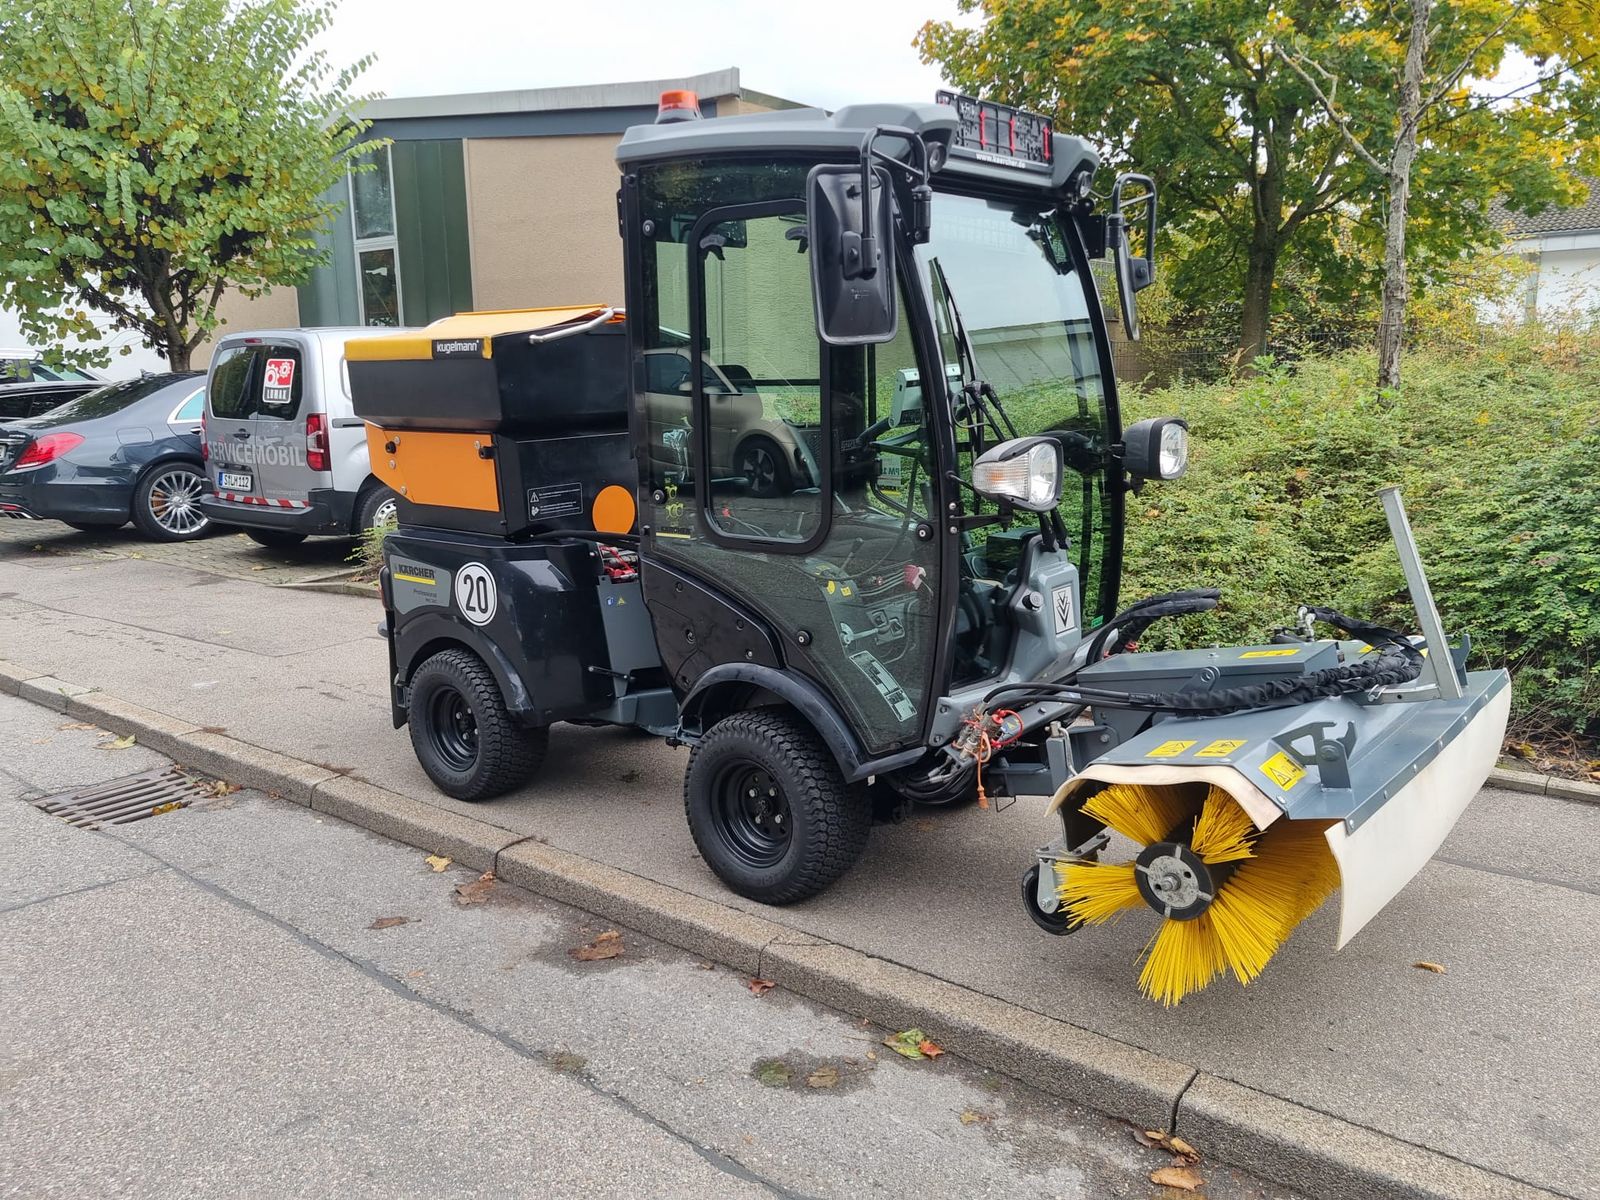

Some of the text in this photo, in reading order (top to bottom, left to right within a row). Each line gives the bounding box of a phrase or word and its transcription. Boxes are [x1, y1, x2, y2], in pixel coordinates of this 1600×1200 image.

[436, 340, 478, 354] kugelmann
[208, 440, 306, 467] SERVICEMOBIL
[463, 573, 489, 614] 20
